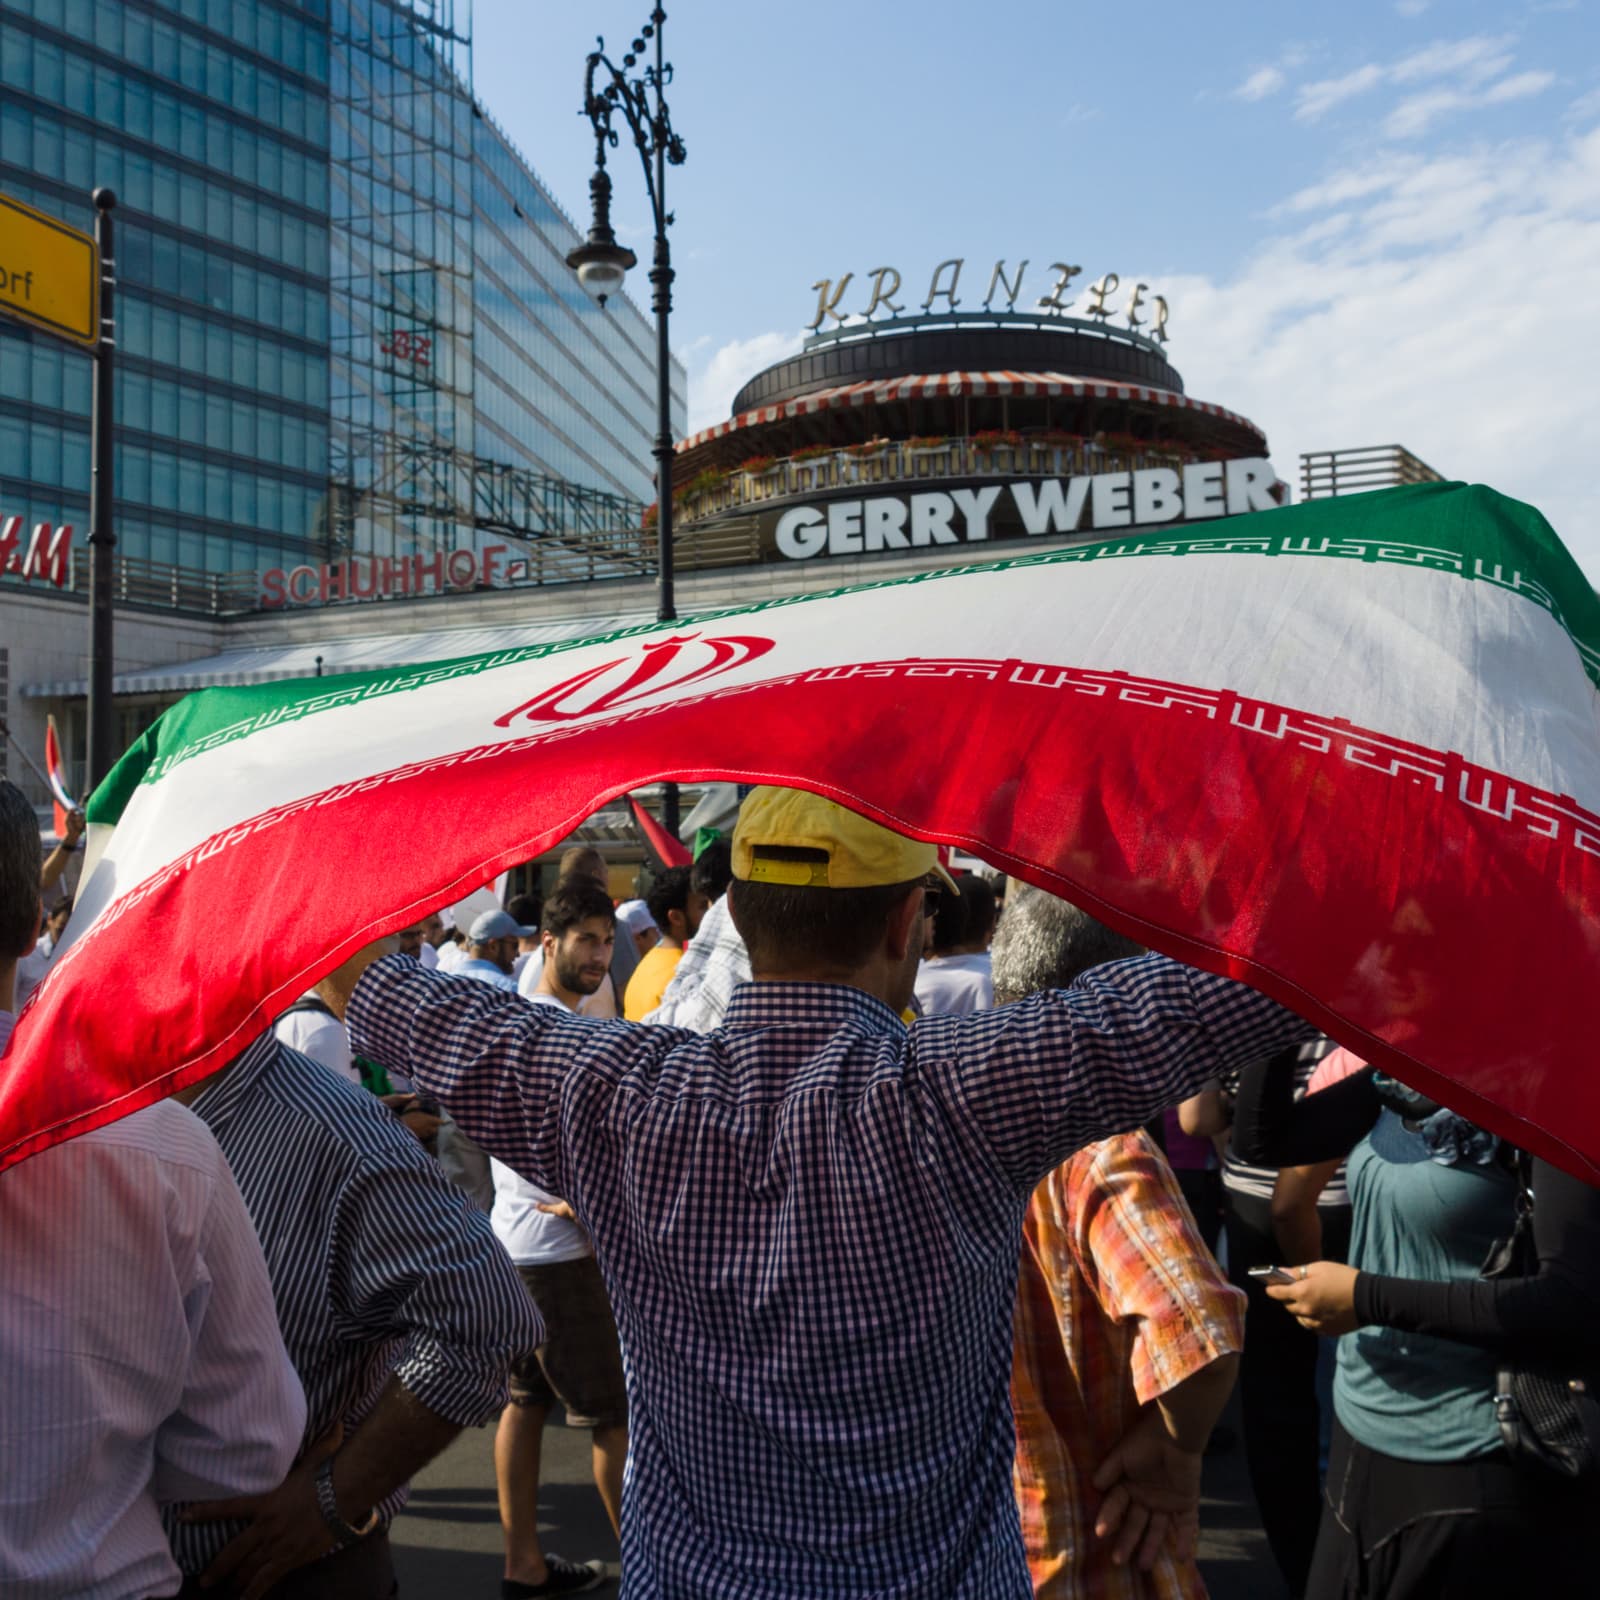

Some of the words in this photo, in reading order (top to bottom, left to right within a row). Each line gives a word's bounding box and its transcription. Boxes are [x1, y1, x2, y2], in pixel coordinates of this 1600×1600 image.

[805, 258, 1170, 341] KRANZLER
[775, 486, 1002, 560] GERRY
[1010, 457, 1279, 535] WEBER
[261, 544, 507, 607] SCHUHHOF
